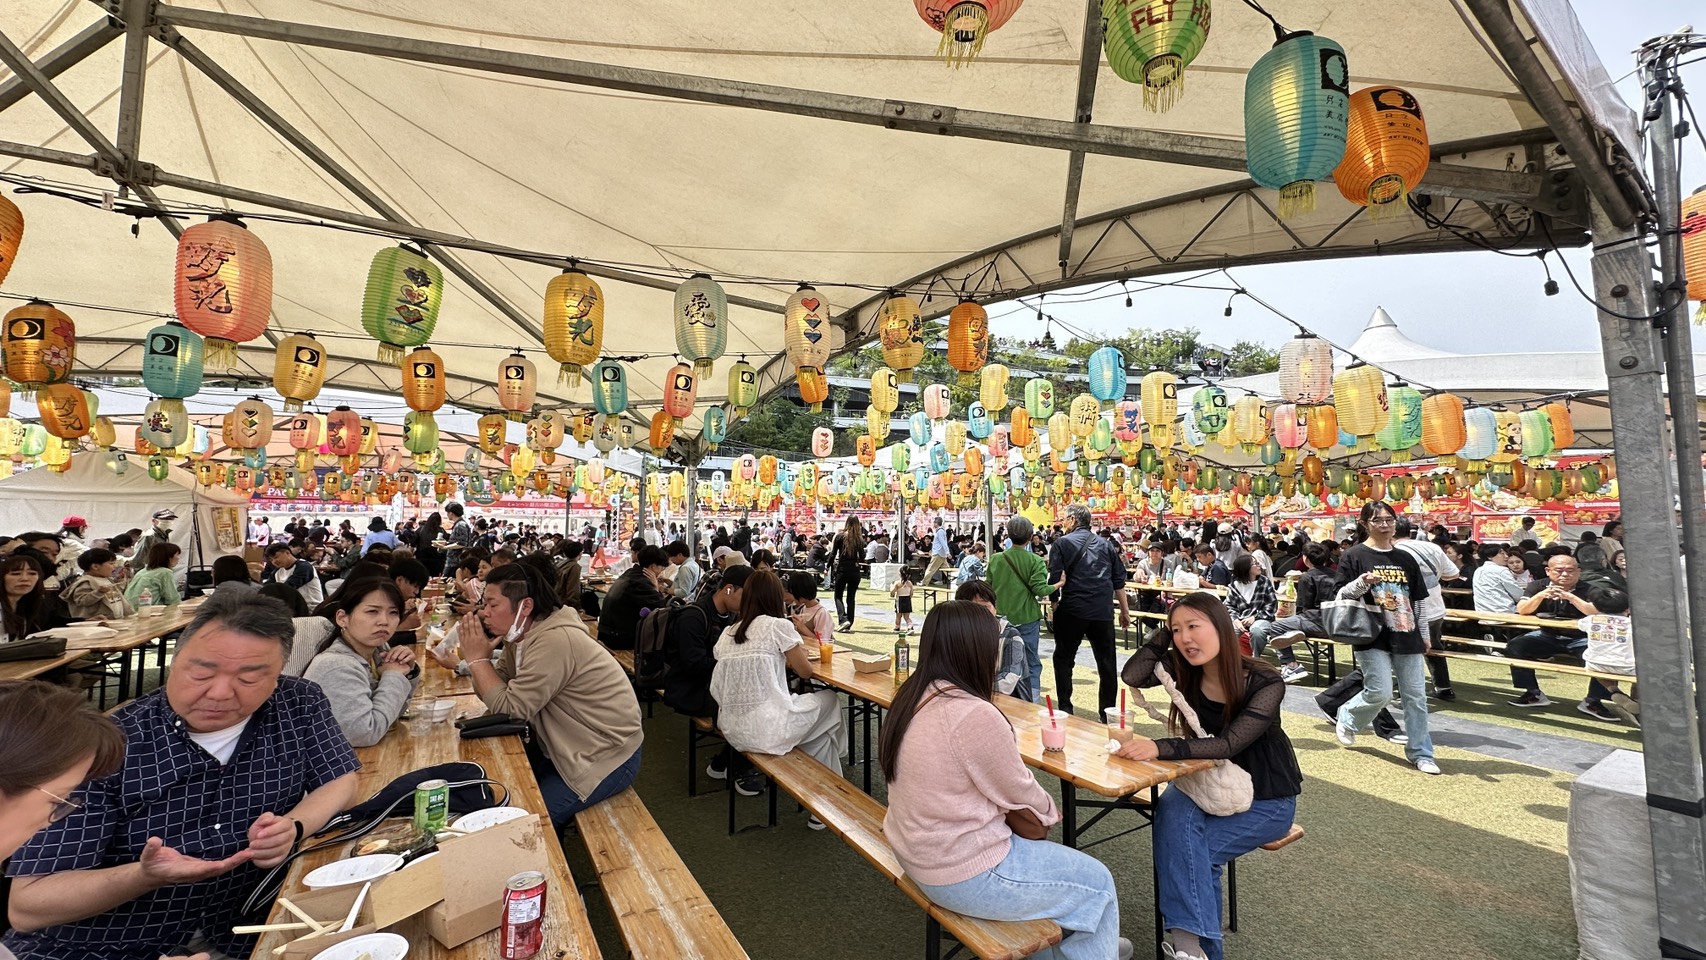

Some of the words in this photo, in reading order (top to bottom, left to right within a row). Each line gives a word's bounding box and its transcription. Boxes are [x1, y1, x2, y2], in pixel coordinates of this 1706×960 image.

[1131, 0, 1177, 34] FLY
[683, 291, 717, 329] 愛
[1381, 575, 1408, 583] OUSE
